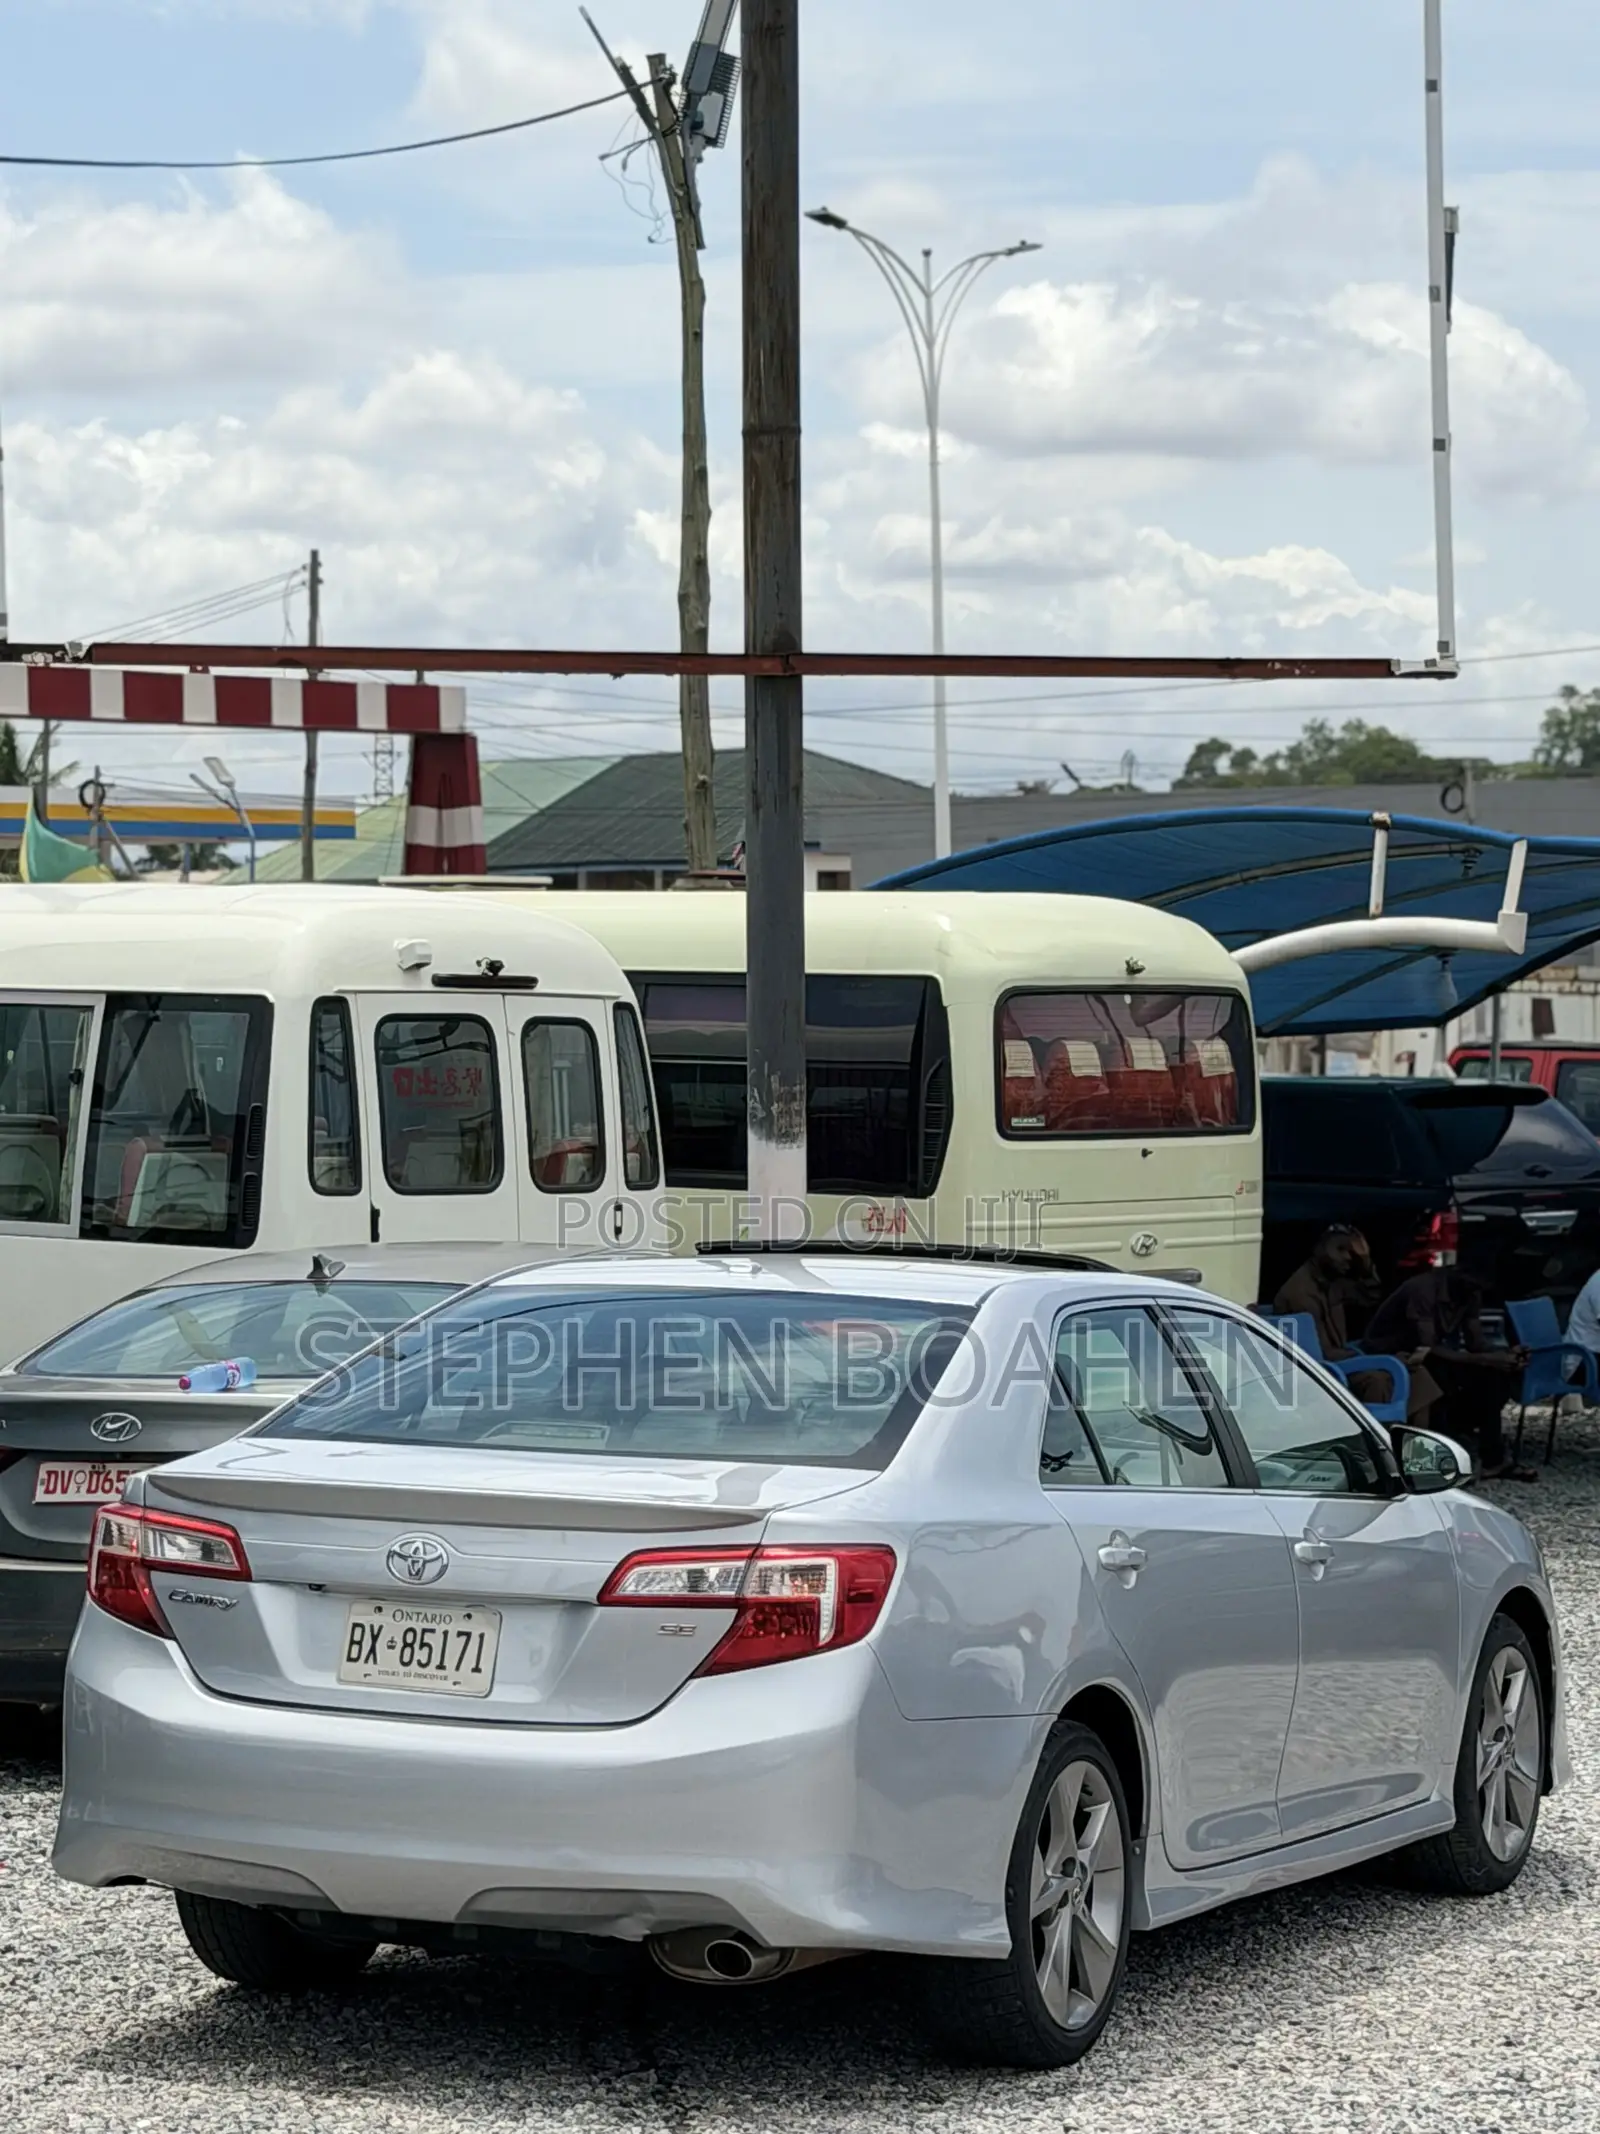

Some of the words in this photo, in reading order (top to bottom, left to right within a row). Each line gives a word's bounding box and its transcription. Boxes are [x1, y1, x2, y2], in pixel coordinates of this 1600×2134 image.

[43, 1469, 74, 1495] DV
[86, 1469, 137, 1495] D65
[392, 1608, 453, 1626] ONTARIO
[657, 1623, 697, 1637] SE
[346, 1622, 384, 1665] BX
[399, 1627, 486, 1674] 85171
